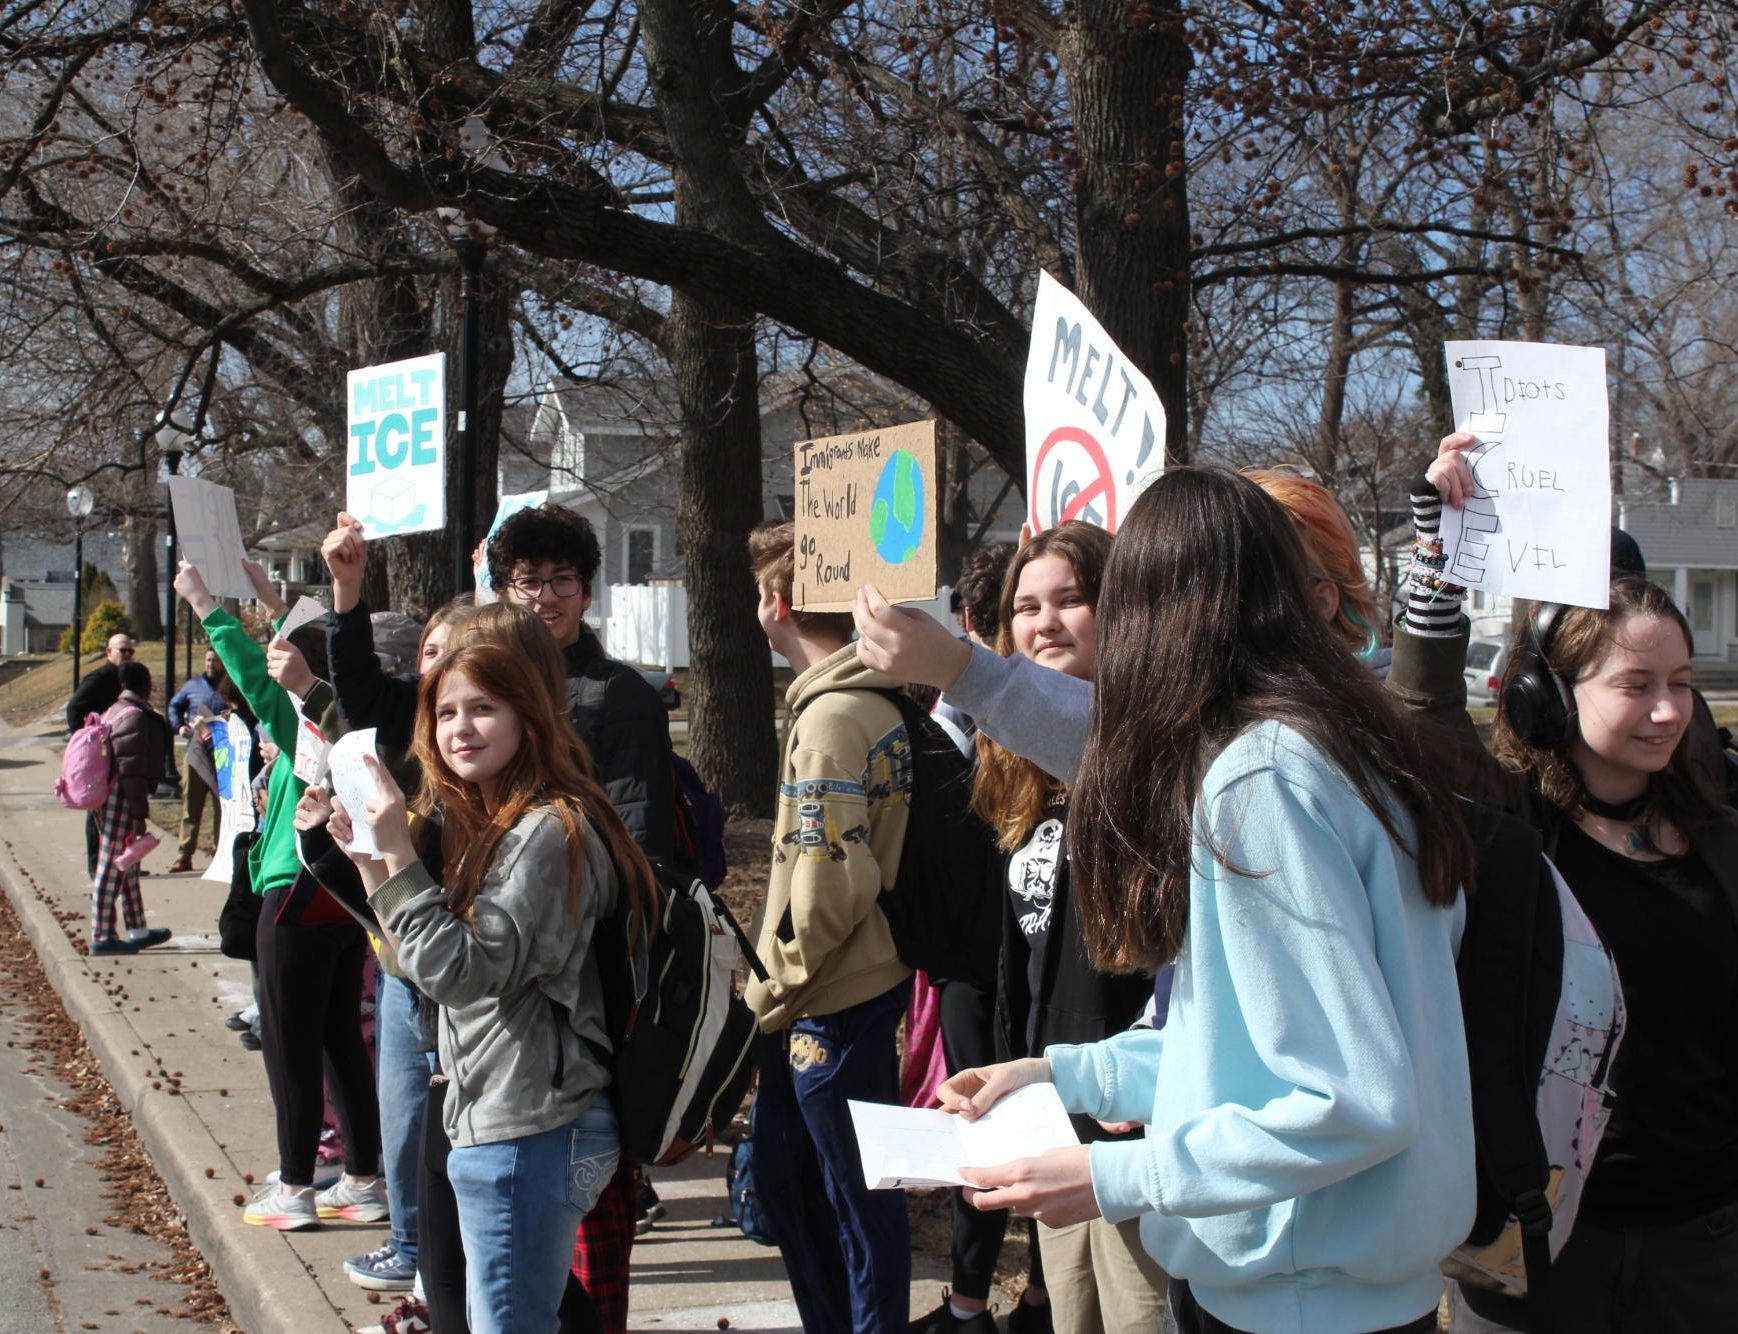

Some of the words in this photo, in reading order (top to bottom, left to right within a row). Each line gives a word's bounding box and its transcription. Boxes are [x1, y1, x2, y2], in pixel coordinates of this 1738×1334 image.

[353, 369, 436, 417] MELT
[350, 408, 438, 477] ICE
[799, 442, 853, 476] Immigrants
[799, 478, 820, 519] The
[823, 483, 857, 520] World
[800, 534, 816, 570] go
[816, 550, 851, 587] Round
